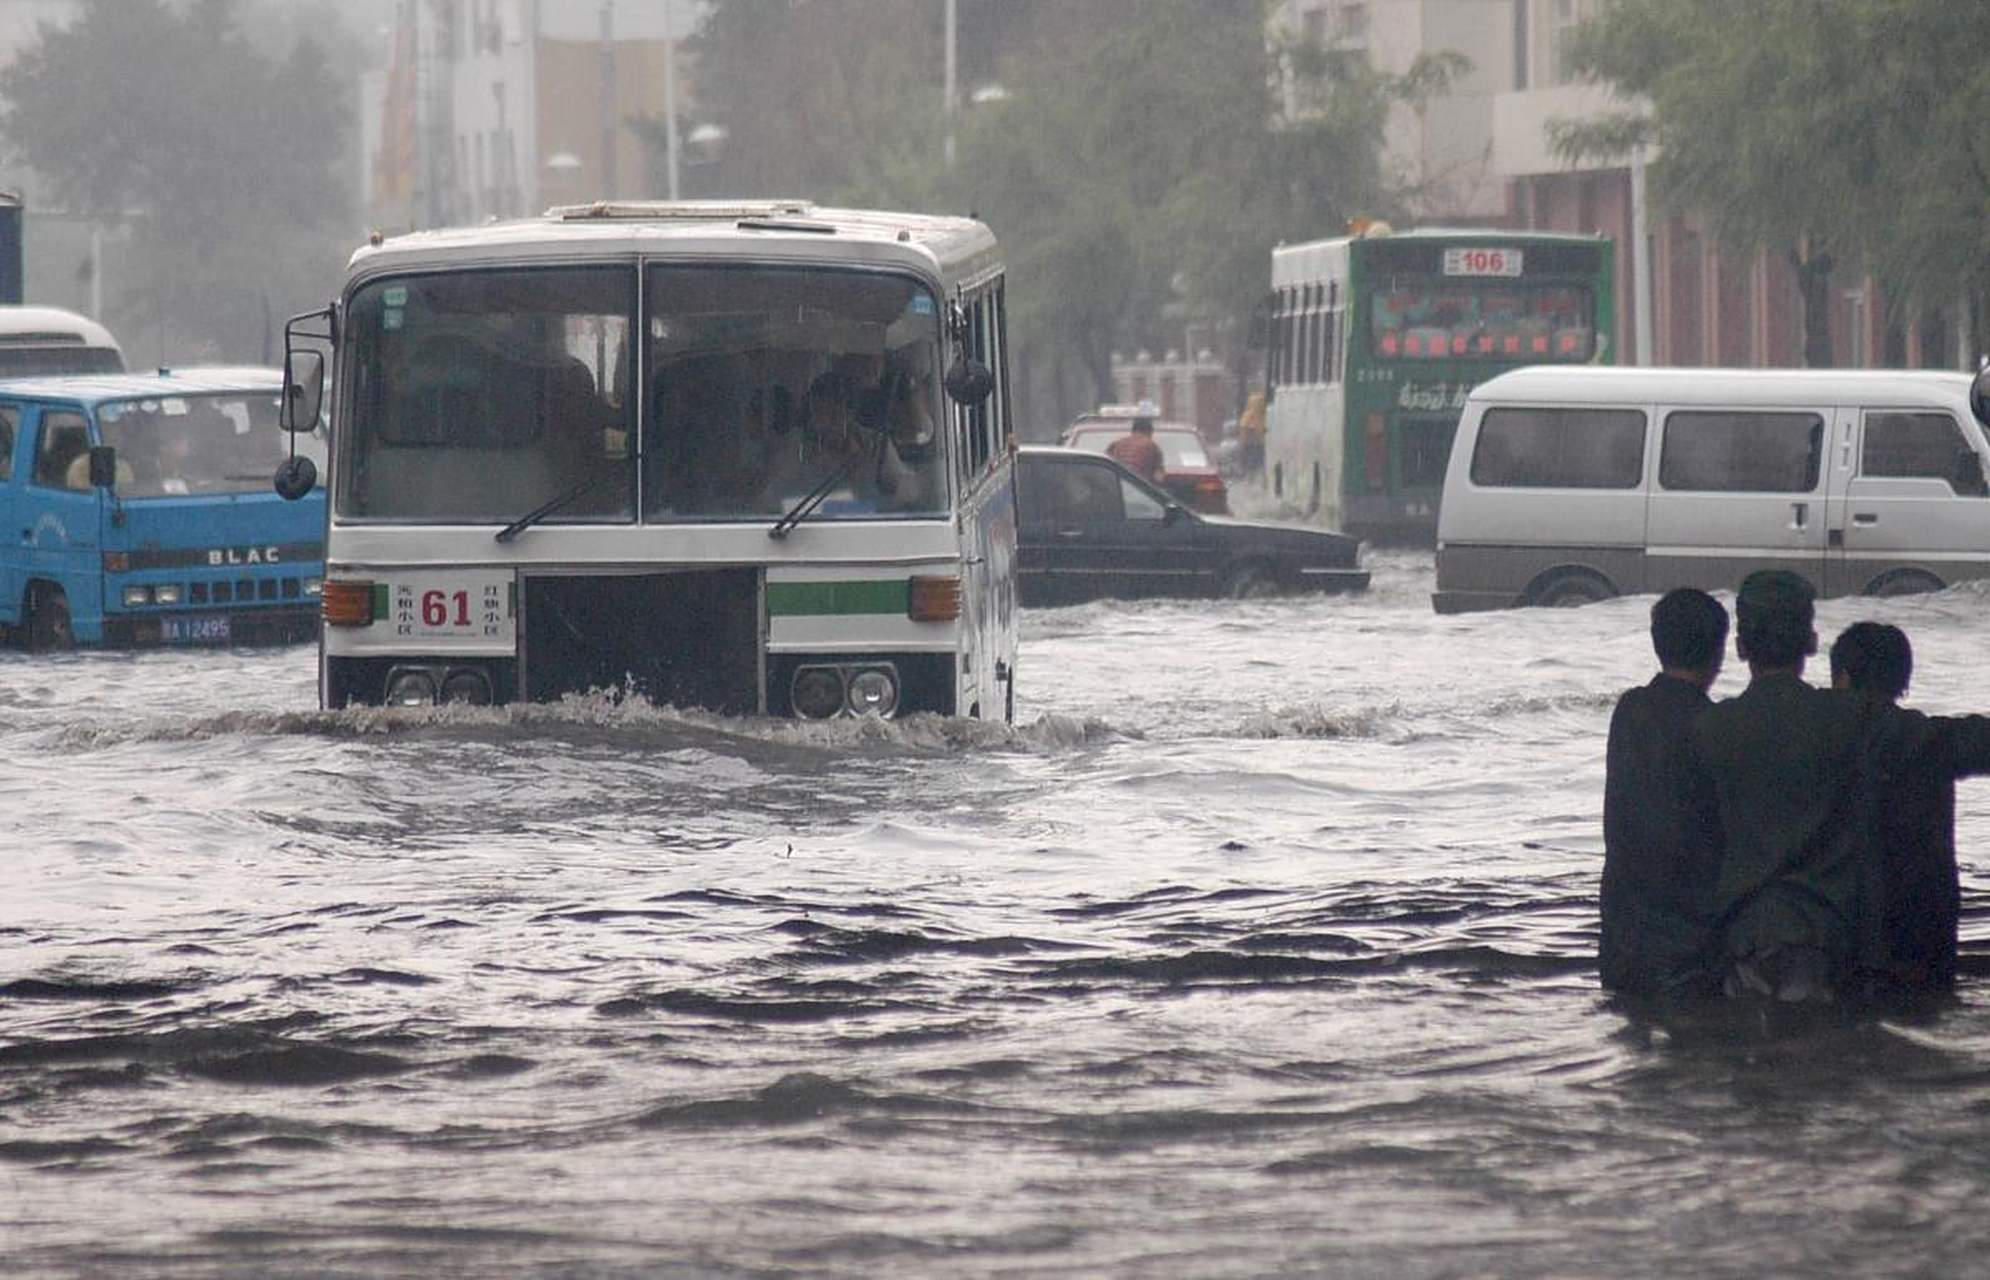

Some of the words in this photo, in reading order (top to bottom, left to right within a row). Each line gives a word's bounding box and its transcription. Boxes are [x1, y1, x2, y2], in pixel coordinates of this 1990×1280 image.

[1463, 252, 1504, 272] 106
[208, 547, 279, 565] BLAC
[422, 589, 472, 626] 61
